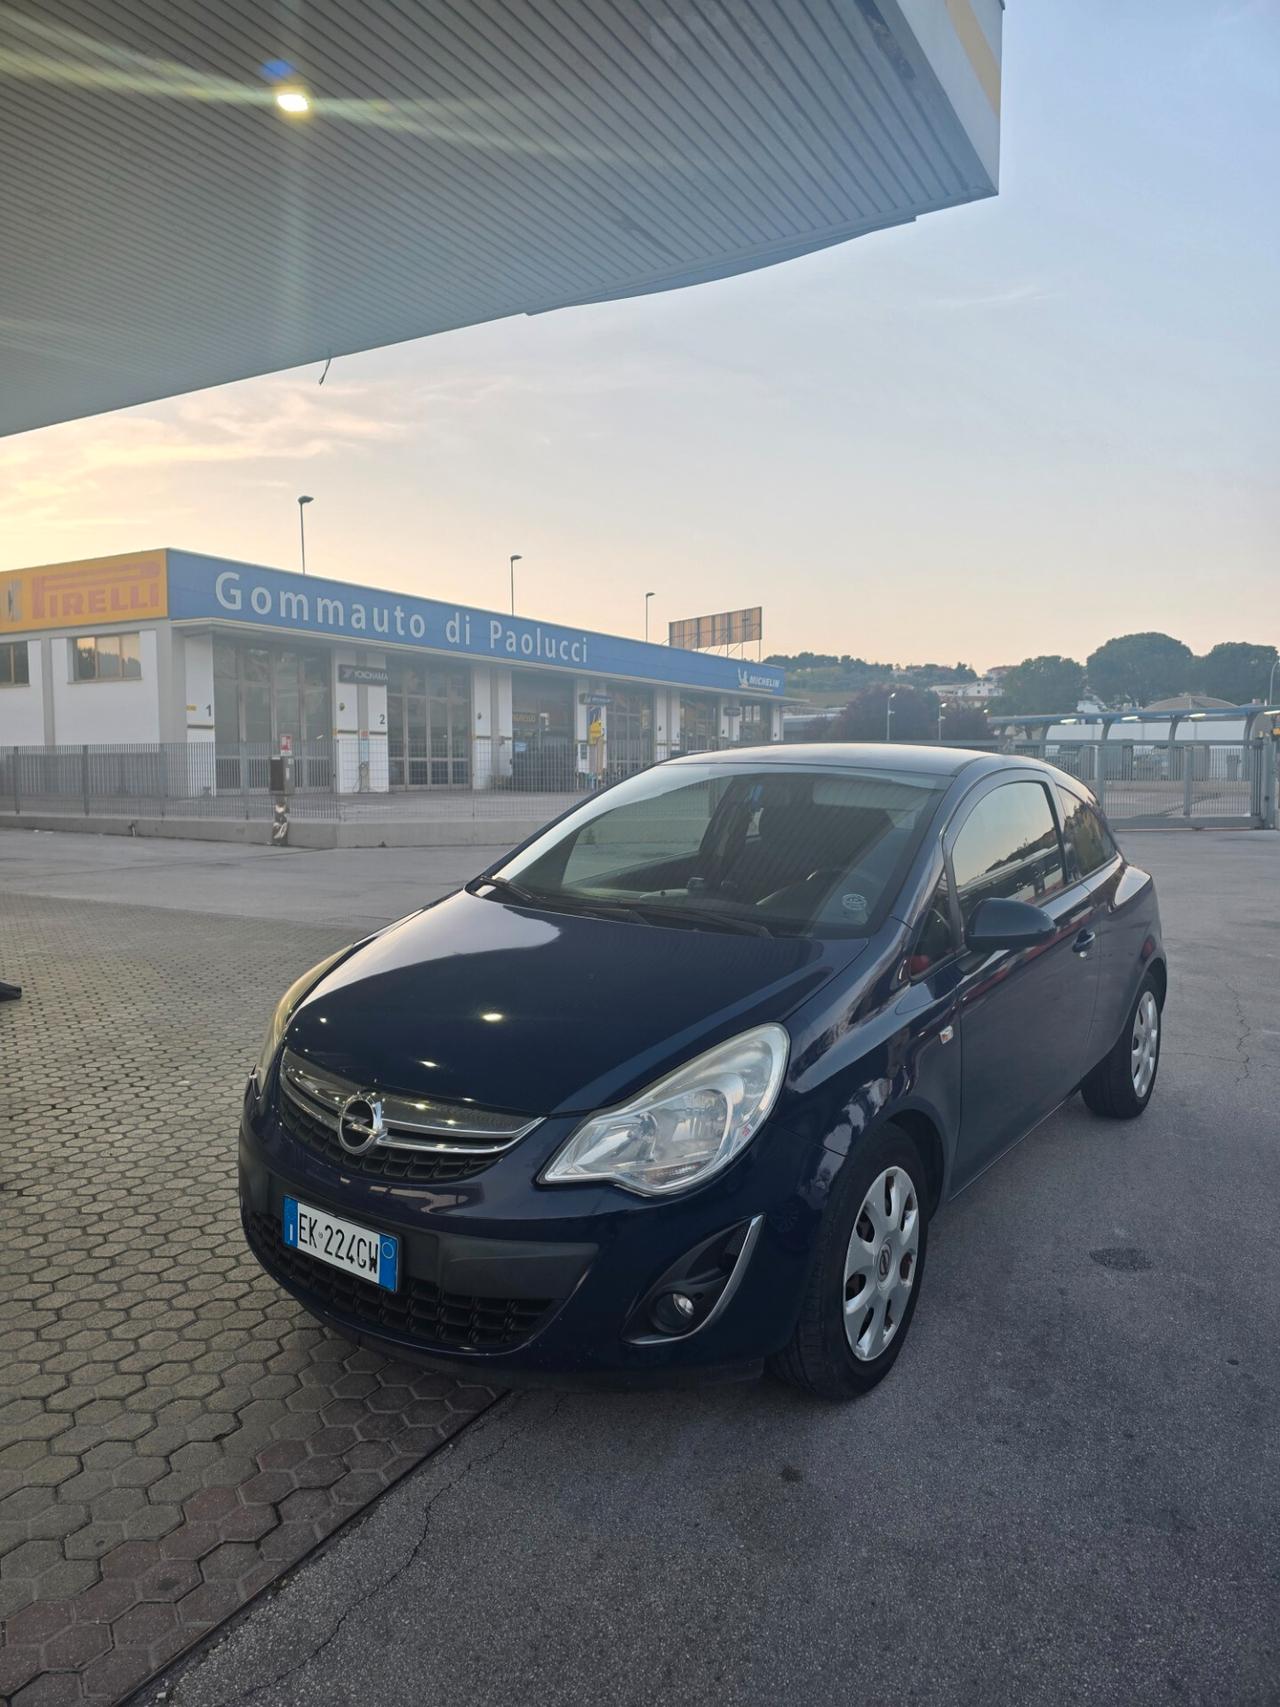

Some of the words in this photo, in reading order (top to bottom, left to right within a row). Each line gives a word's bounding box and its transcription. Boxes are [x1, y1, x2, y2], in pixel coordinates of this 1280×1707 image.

[32, 560, 161, 620] PIRELLI
[215, 571, 425, 638] Gommauto
[445, 610, 471, 645] di
[489, 619, 588, 664] Paolucci
[749, 675, 780, 688] MICHELIN
[205, 703, 212, 717] 1
[379, 713, 386, 725] 2
